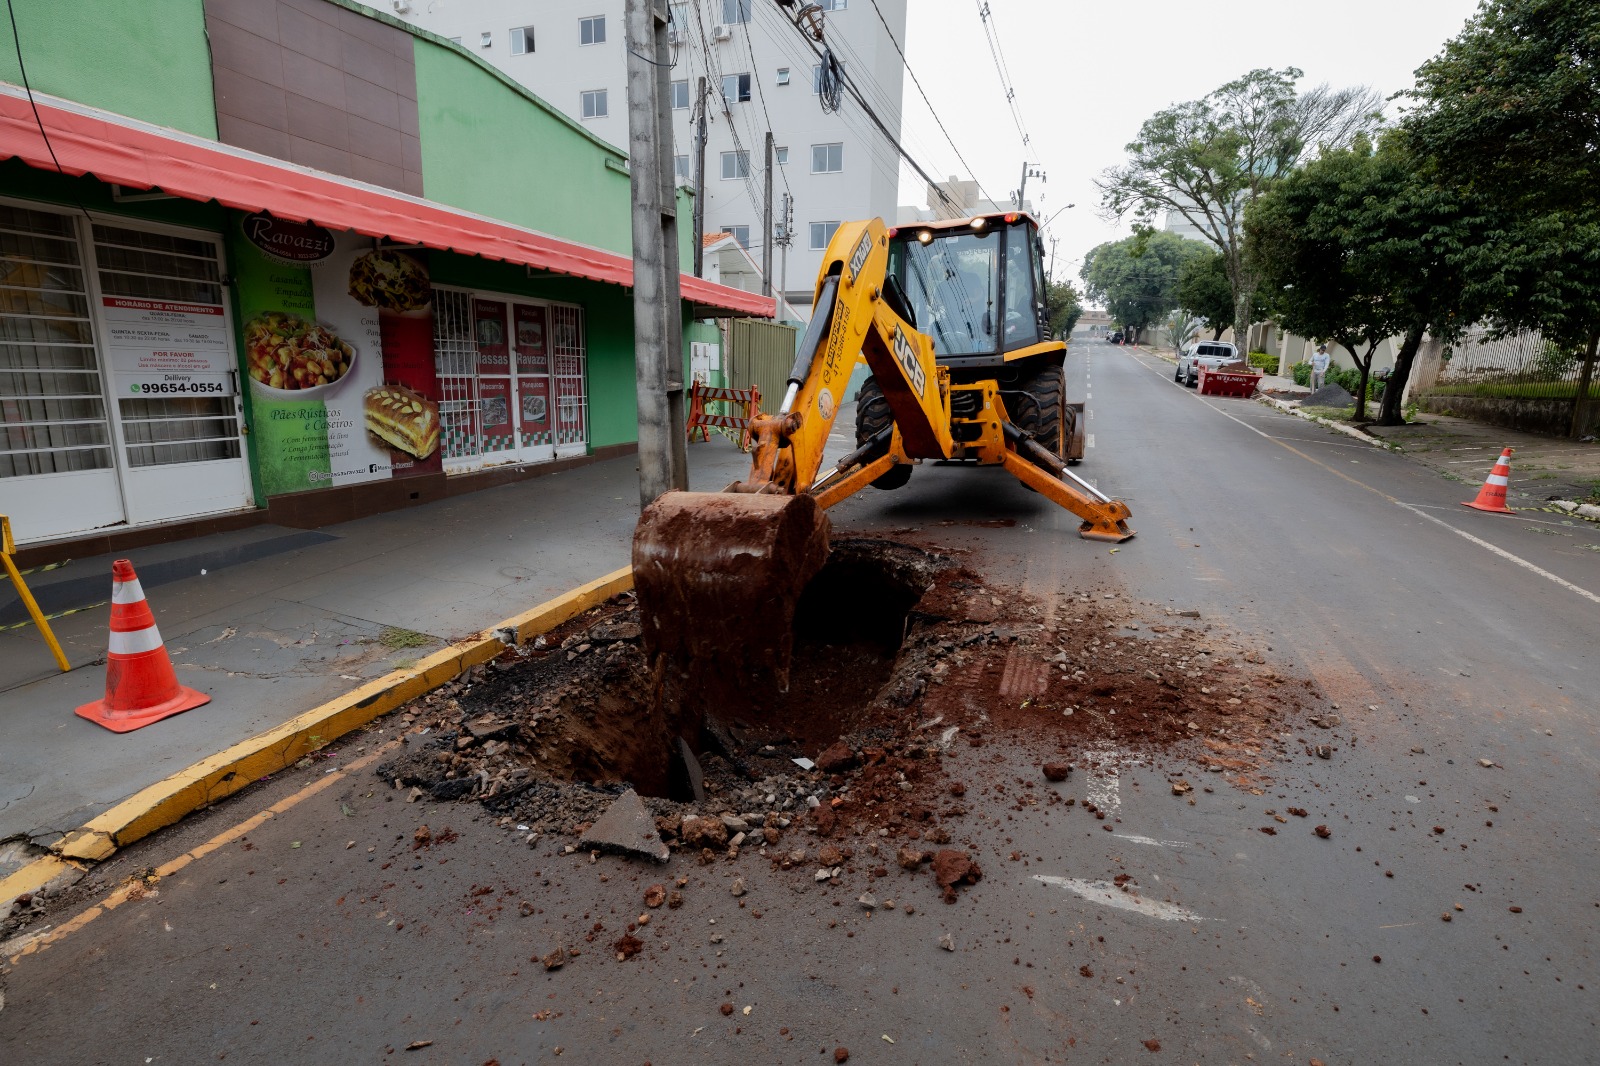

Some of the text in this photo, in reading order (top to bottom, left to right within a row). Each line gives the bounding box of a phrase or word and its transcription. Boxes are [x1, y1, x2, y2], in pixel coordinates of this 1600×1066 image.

[252, 216, 329, 251] Ravazzi
[269, 273, 302, 286] Lasanha
[115, 299, 151, 309] HORÁRIO
[165, 304, 214, 314] ATENDIMENTO
[516, 352, 547, 365] Ravazzi
[894, 328, 925, 398] JCB
[164, 374, 191, 382] Dellivery
[141, 382, 223, 394] 99654-0554
[271, 406, 341, 420] Pães Rústicos
[305, 418, 354, 431] e Caseiros
